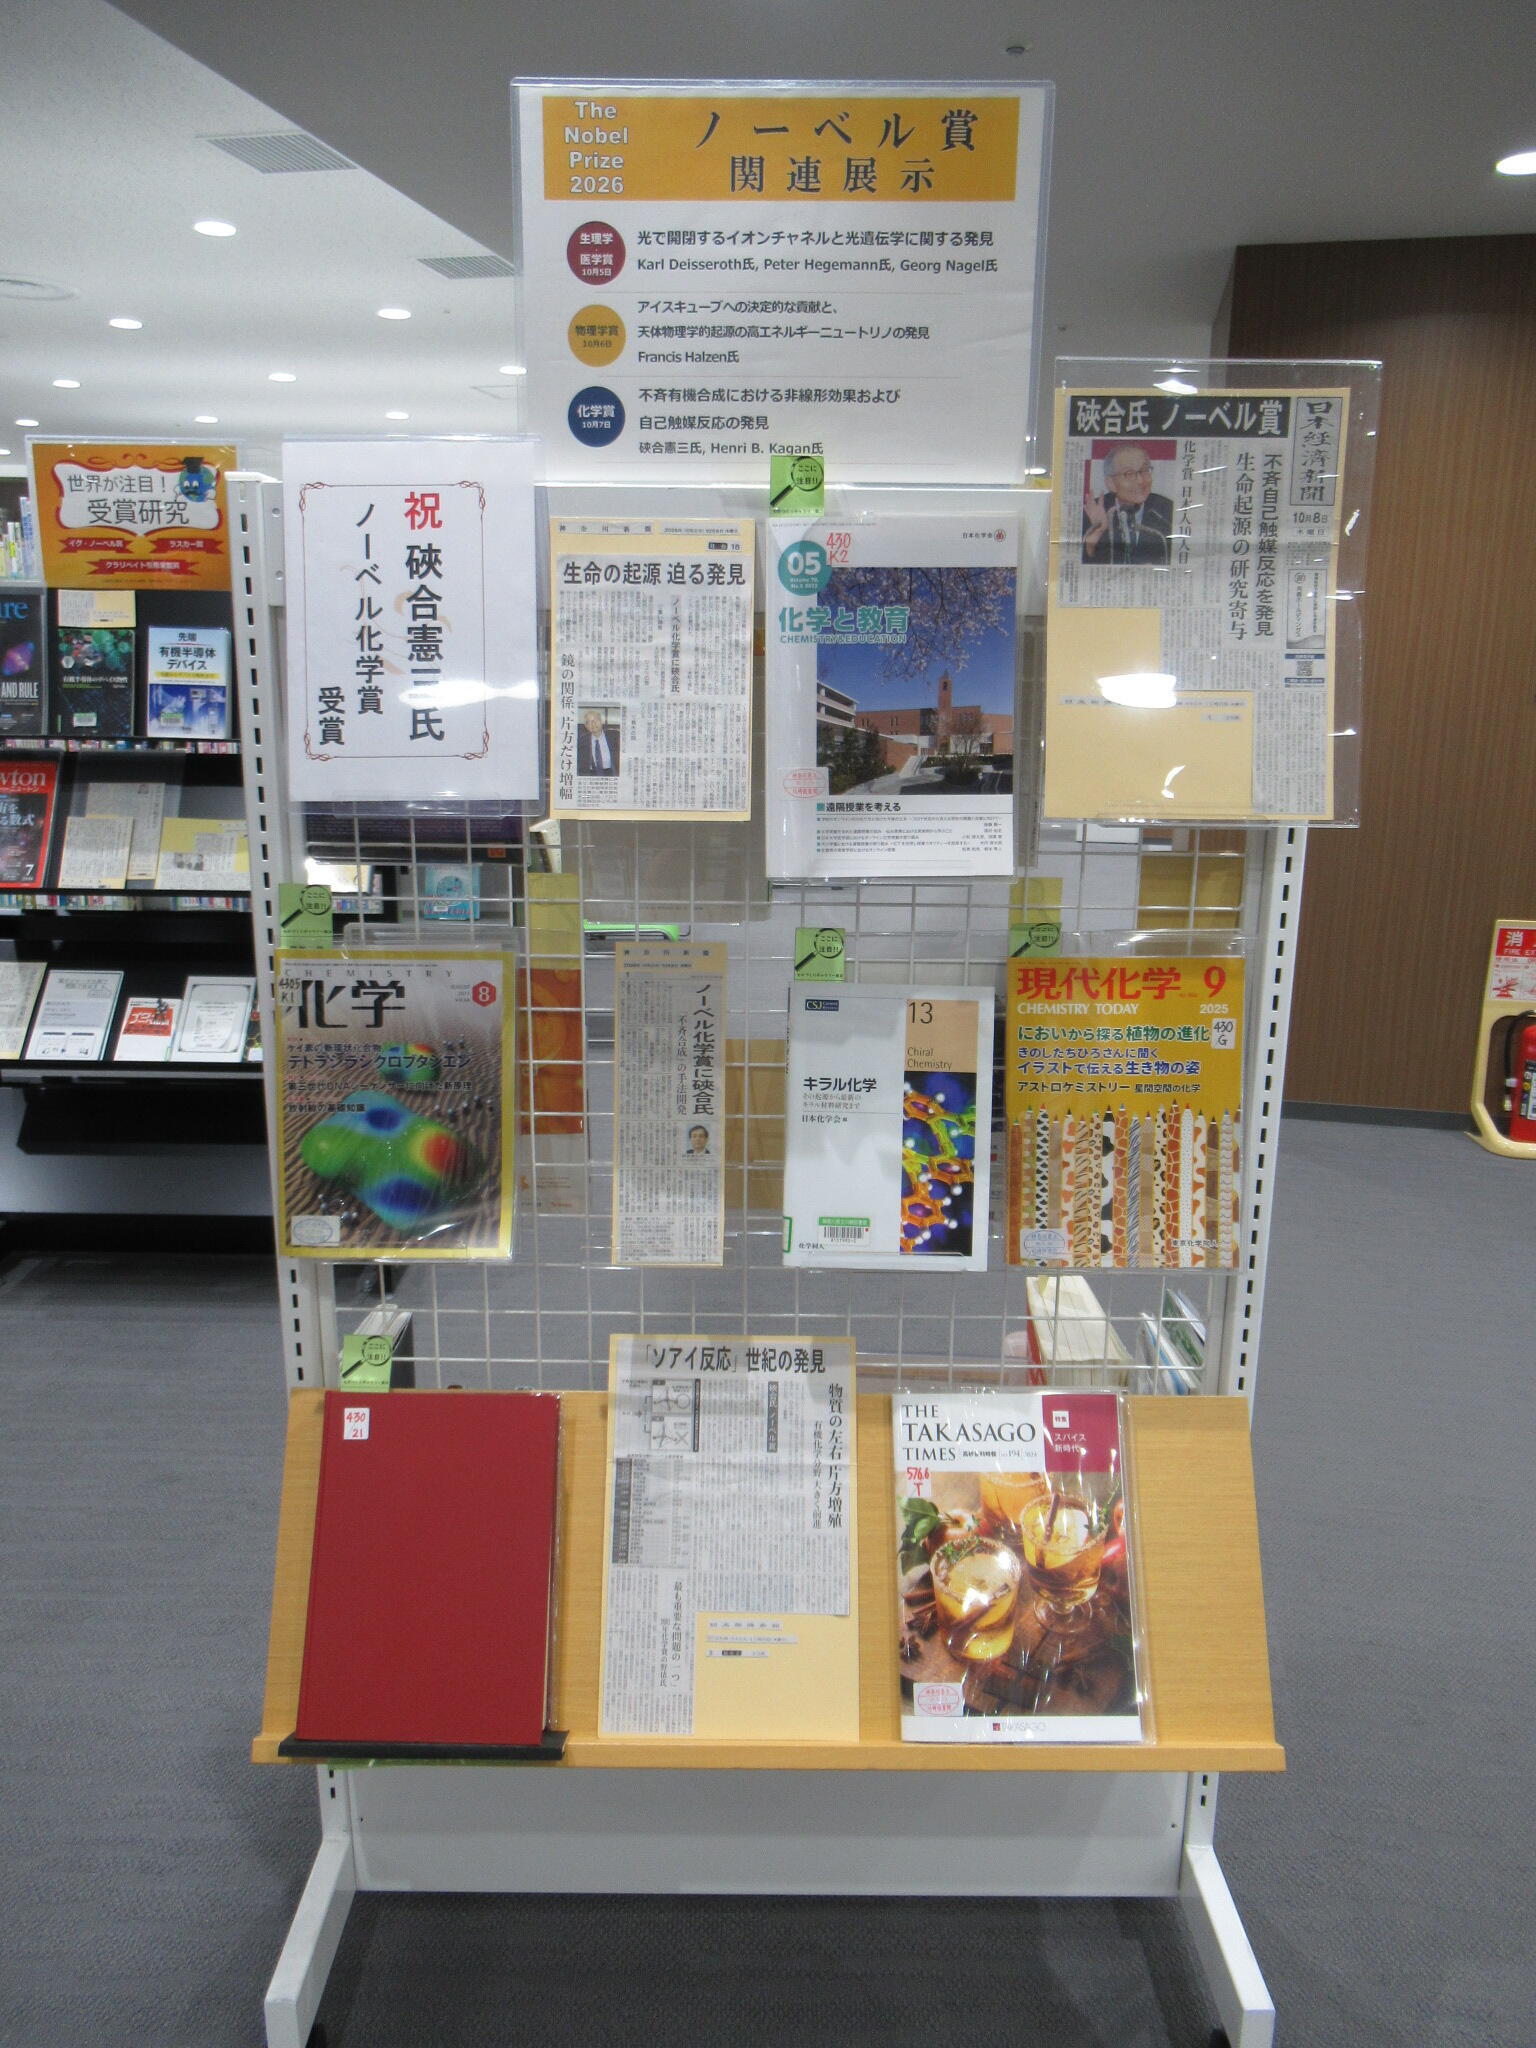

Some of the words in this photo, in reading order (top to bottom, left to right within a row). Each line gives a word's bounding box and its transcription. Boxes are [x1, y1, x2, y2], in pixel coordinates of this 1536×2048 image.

[575, 101, 617, 119] The
[564, 127, 629, 145] Nobel
[695, 109, 979, 153] ノーベル賞
[569, 152, 624, 169] Prize
[729, 156, 935, 193] 関連展示
[569, 176, 625, 194] 2026
[579, 232, 613, 245] 生理学
[637, 230, 994, 247] 光で開閉するイオンチャネルと光遺伝学に関する発見
[580, 253, 614, 266] 医学賞
[638, 257, 664, 271] Karl
[669, 257, 760, 273] Deisseroth氏,
[764, 258, 800, 272] Peter
[804, 258, 896, 275] Hegemann氏,
[900, 258, 942, 275] Georg
[946, 258, 998, 275] Nagel氏
[638, 300, 838, 315] アイスキューブへの決定的な貢献と、
[575, 325, 619, 338] 物理学賞
[637, 325, 930, 340] 天体物理学的起源の高エネルギーニュートリノの発見
[638, 351, 681, 363] Francis
[685, 350, 739, 364] Halzen氏
[639, 388, 901, 404] 不斉有機合成における非線形効果および
[577, 404, 615, 418] 化学賞
[1161, 400, 1283, 436] ノーベル賞
[639, 415, 770, 430] 自己触媒反応の発見
[710, 442, 747, 454] Henri
[751, 442, 765, 454] B.
[769, 442, 823, 457] Kagan氏
[1299, 400, 1333, 501] 日本経済新聞
[1181, 440, 1196, 480] 化学賞
[88, 499, 190, 525] 受賞研究
[404, 491, 443, 530] 祝
[1293, 512, 1329, 524] 10月8日
[827, 532, 851, 549] 430
[1228, 453, 1256, 640] 生命起源の研究寄与
[1254, 453, 1283, 636] 不斉自己触媒反応を発見
[787, 551, 821, 577] 05
[563, 561, 662, 586] 生命の起源
[667, 562, 746, 586] 迫る発見
[355, 503, 384, 715] ノーベル化学賞
[779, 606, 911, 633] 化学と教育
[780, 634, 907, 645] CHEMISTRY&EDUCATION
[159, 646, 216, 659] 有機半導体
[167, 659, 208, 671] デバイス
[318, 686, 345, 745] 受賞
[559, 653, 575, 801] 鏡の関係、片方だけ増幅
[826, 802, 901, 813] 遠隔授業を考える
[25, 864, 34, 876] 7
[1017, 967, 1181, 1000] 現代化学
[1203, 965, 1226, 998] 9
[478, 985, 490, 1003] 8
[285, 980, 406, 1029] 化学
[908, 1002, 933, 1024] 13
[1017, 1003, 1089, 1015] CHEMISTRY
[1095, 1003, 1140, 1015] TODAY
[1200, 1003, 1229, 1014] 2025
[1018, 1025, 1210, 1042] においから探る植物の進化
[1213, 1021, 1234, 1033] 430
[908, 1047, 934, 1057] Chiral
[1018, 1047, 1159, 1059] きのしたちひろさんに聞く
[907, 1058, 952, 1070] Chemistry
[1018, 1060, 1200, 1075] イラストで伝える生き物の姿
[803, 1077, 877, 1092] キラル化学
[1018, 1081, 1130, 1093] アストロケミストリー
[1134, 1083, 1201, 1093] 星間空間の化学
[802, 1114, 841, 1123] 日本化学会
[645, 1344, 826, 1374] 「ソアイ反応」世紀の発見
[346, 1412, 366, 1423] 430
[902, 1404, 939, 1418] THE
[828, 1383, 843, 1461] 物質の左右
[352, 1428, 363, 1439] 21
[902, 1423, 1036, 1443] TAKASAGO
[1054, 1433, 1087, 1442] スパイス
[903, 1447, 956, 1462] TIMES
[828, 1464, 843, 1529] 片方増殖
